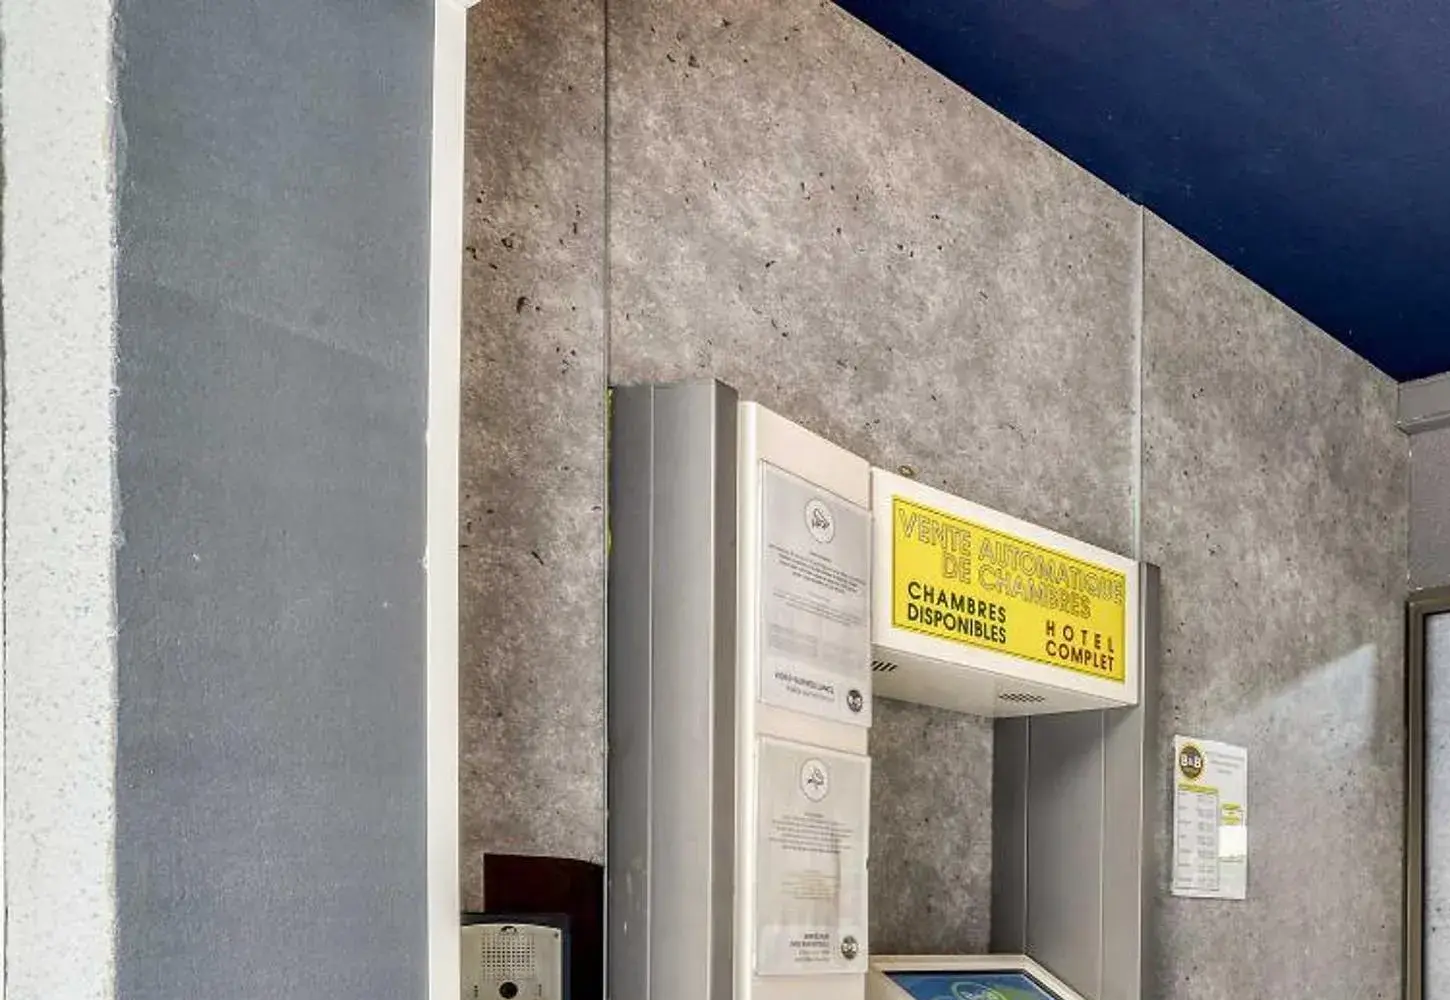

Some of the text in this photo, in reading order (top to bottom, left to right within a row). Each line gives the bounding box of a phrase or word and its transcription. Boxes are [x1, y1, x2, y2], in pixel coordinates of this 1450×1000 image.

[898, 508, 1124, 605] VENTE AUTOMATIQUE
[907, 581, 1007, 622] CHAMBRES
[942, 554, 1091, 618] DE CHAMBRES
[907, 603, 1007, 643] DISPONIBLES
[1045, 620, 1115, 653] HOTEL
[1045, 639, 1115, 672] COMPLET
